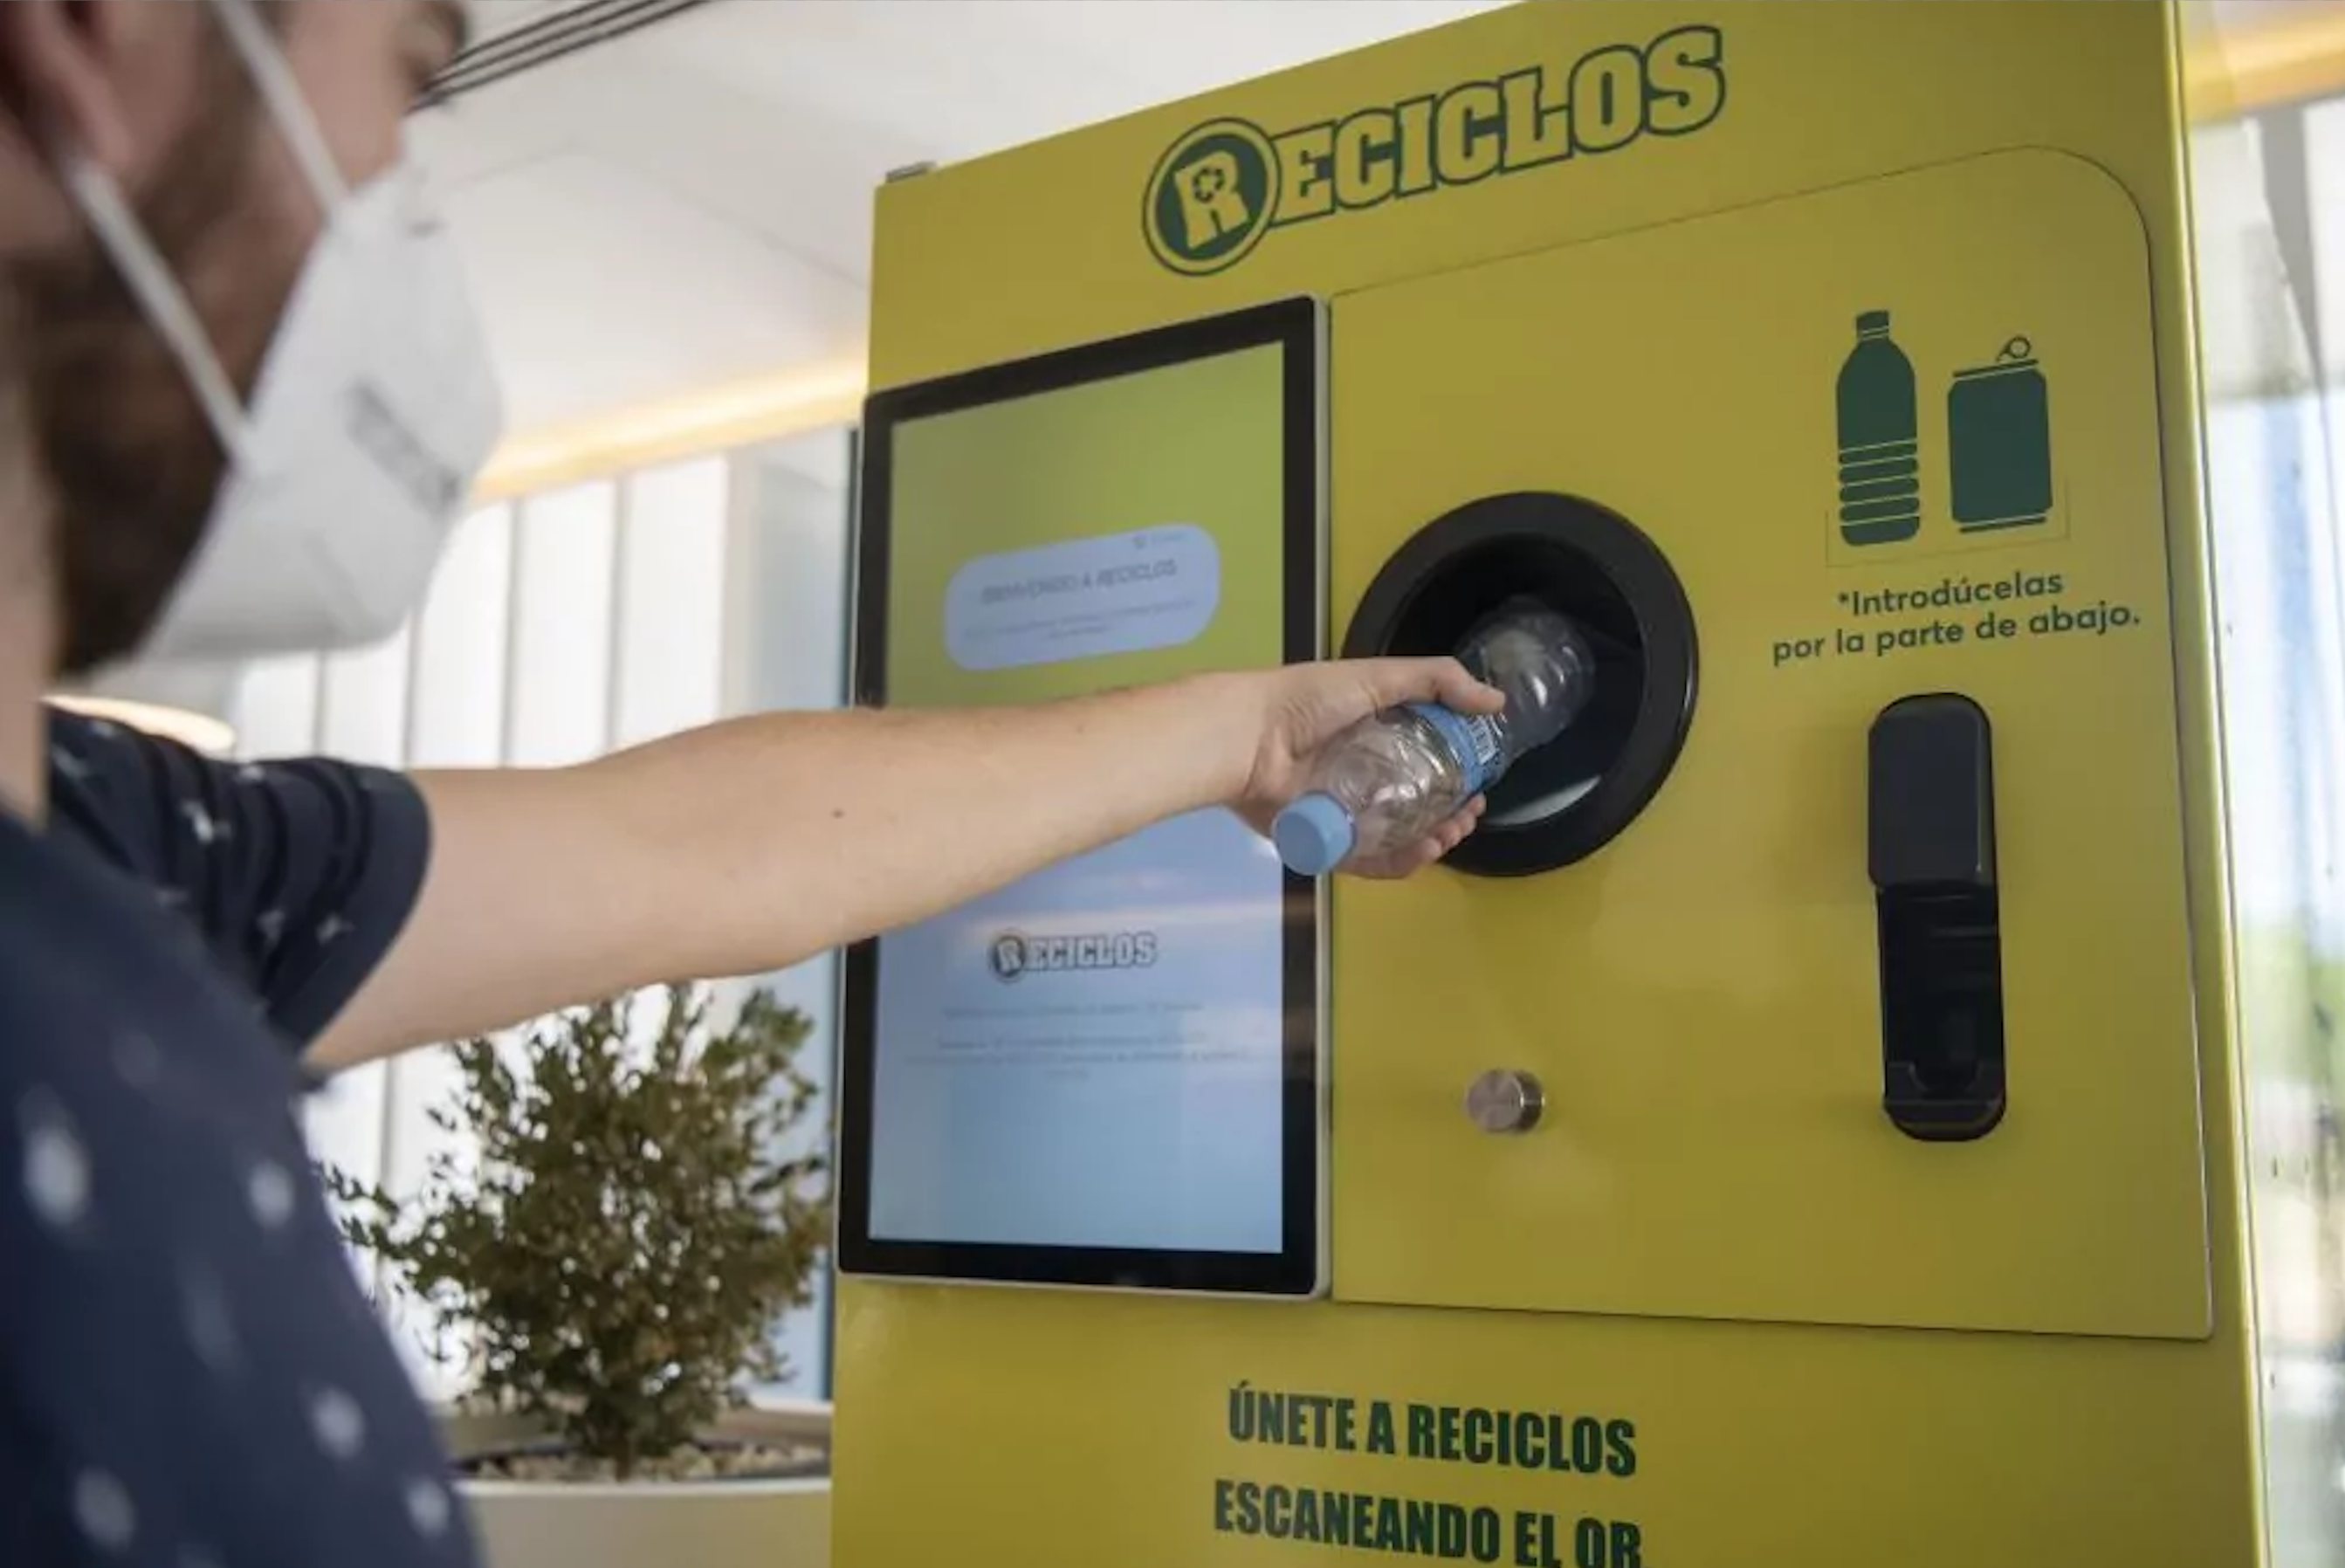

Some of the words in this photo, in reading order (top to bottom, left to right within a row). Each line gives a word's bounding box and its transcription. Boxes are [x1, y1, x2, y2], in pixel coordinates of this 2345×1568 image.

[1143, 24, 1725, 276] RECICLOS
[1773, 635, 1826, 666] por
[1836, 629, 1864, 655] la
[1877, 620, 1963, 657] parte
[1976, 612, 2017, 638] de
[2030, 601, 2141, 635] abajo.
[990, 929, 1158, 983] RECICLOS
[1229, 1380, 1355, 1452] ÚNETE
[1366, 1402, 1395, 1455] A
[1408, 1405, 1636, 1476] RECICLOS
[1214, 1480, 1500, 1563] ESCANEANDO
[1516, 1511, 1562, 1568] EL
